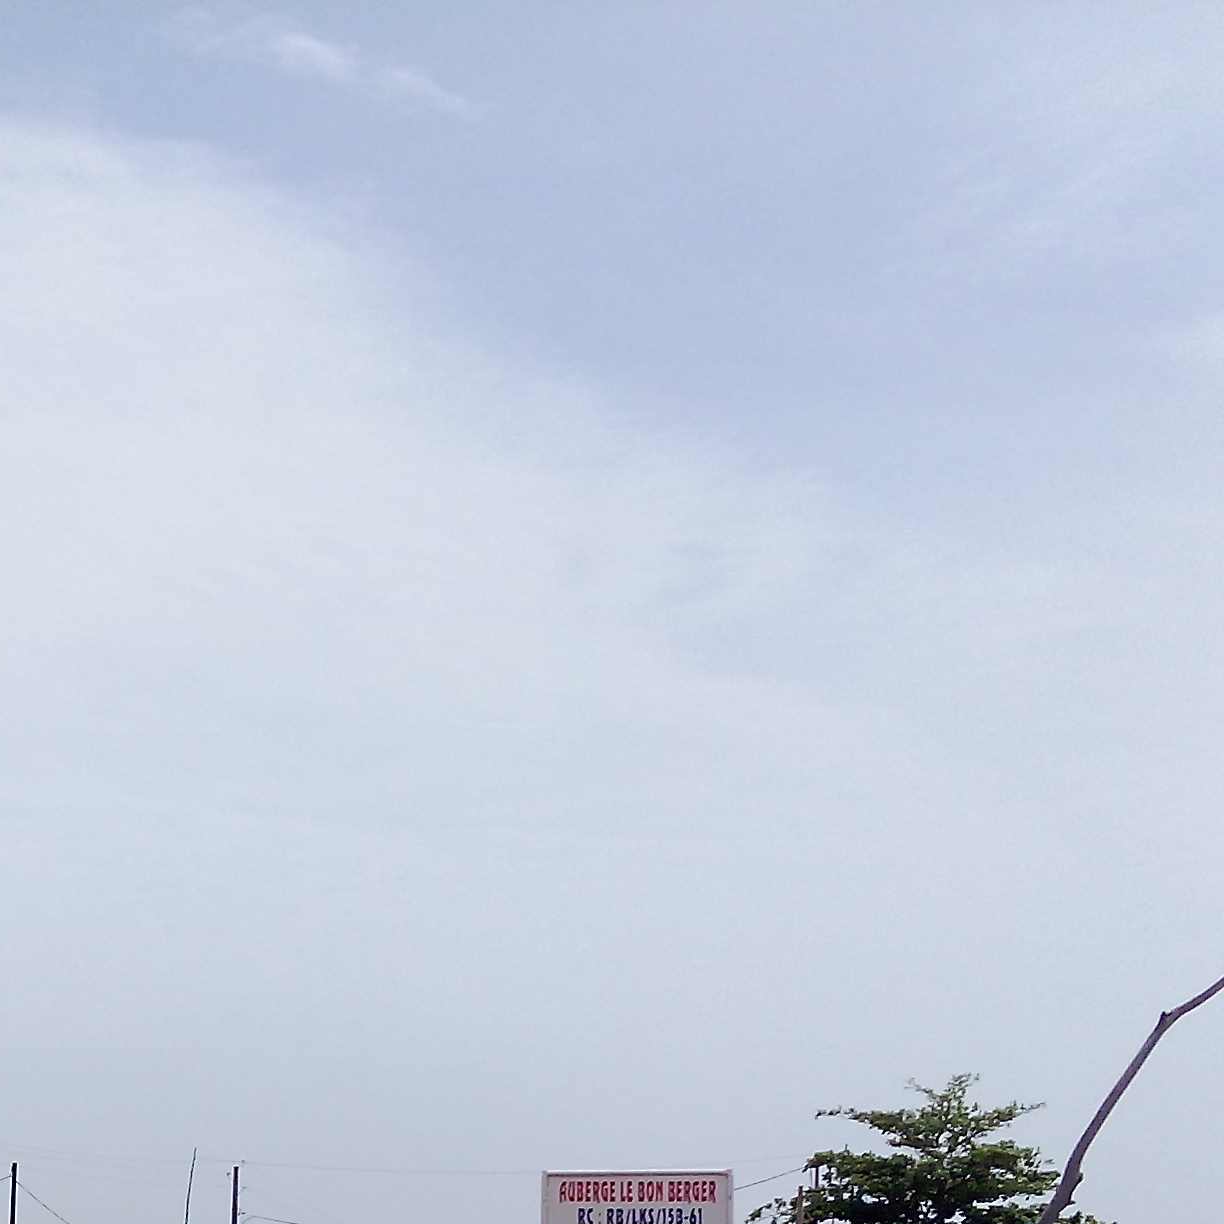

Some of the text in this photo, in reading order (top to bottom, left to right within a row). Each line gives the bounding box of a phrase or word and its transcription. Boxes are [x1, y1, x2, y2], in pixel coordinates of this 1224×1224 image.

[559, 1181, 717, 1203] AUBERGE LE BON BERGER
